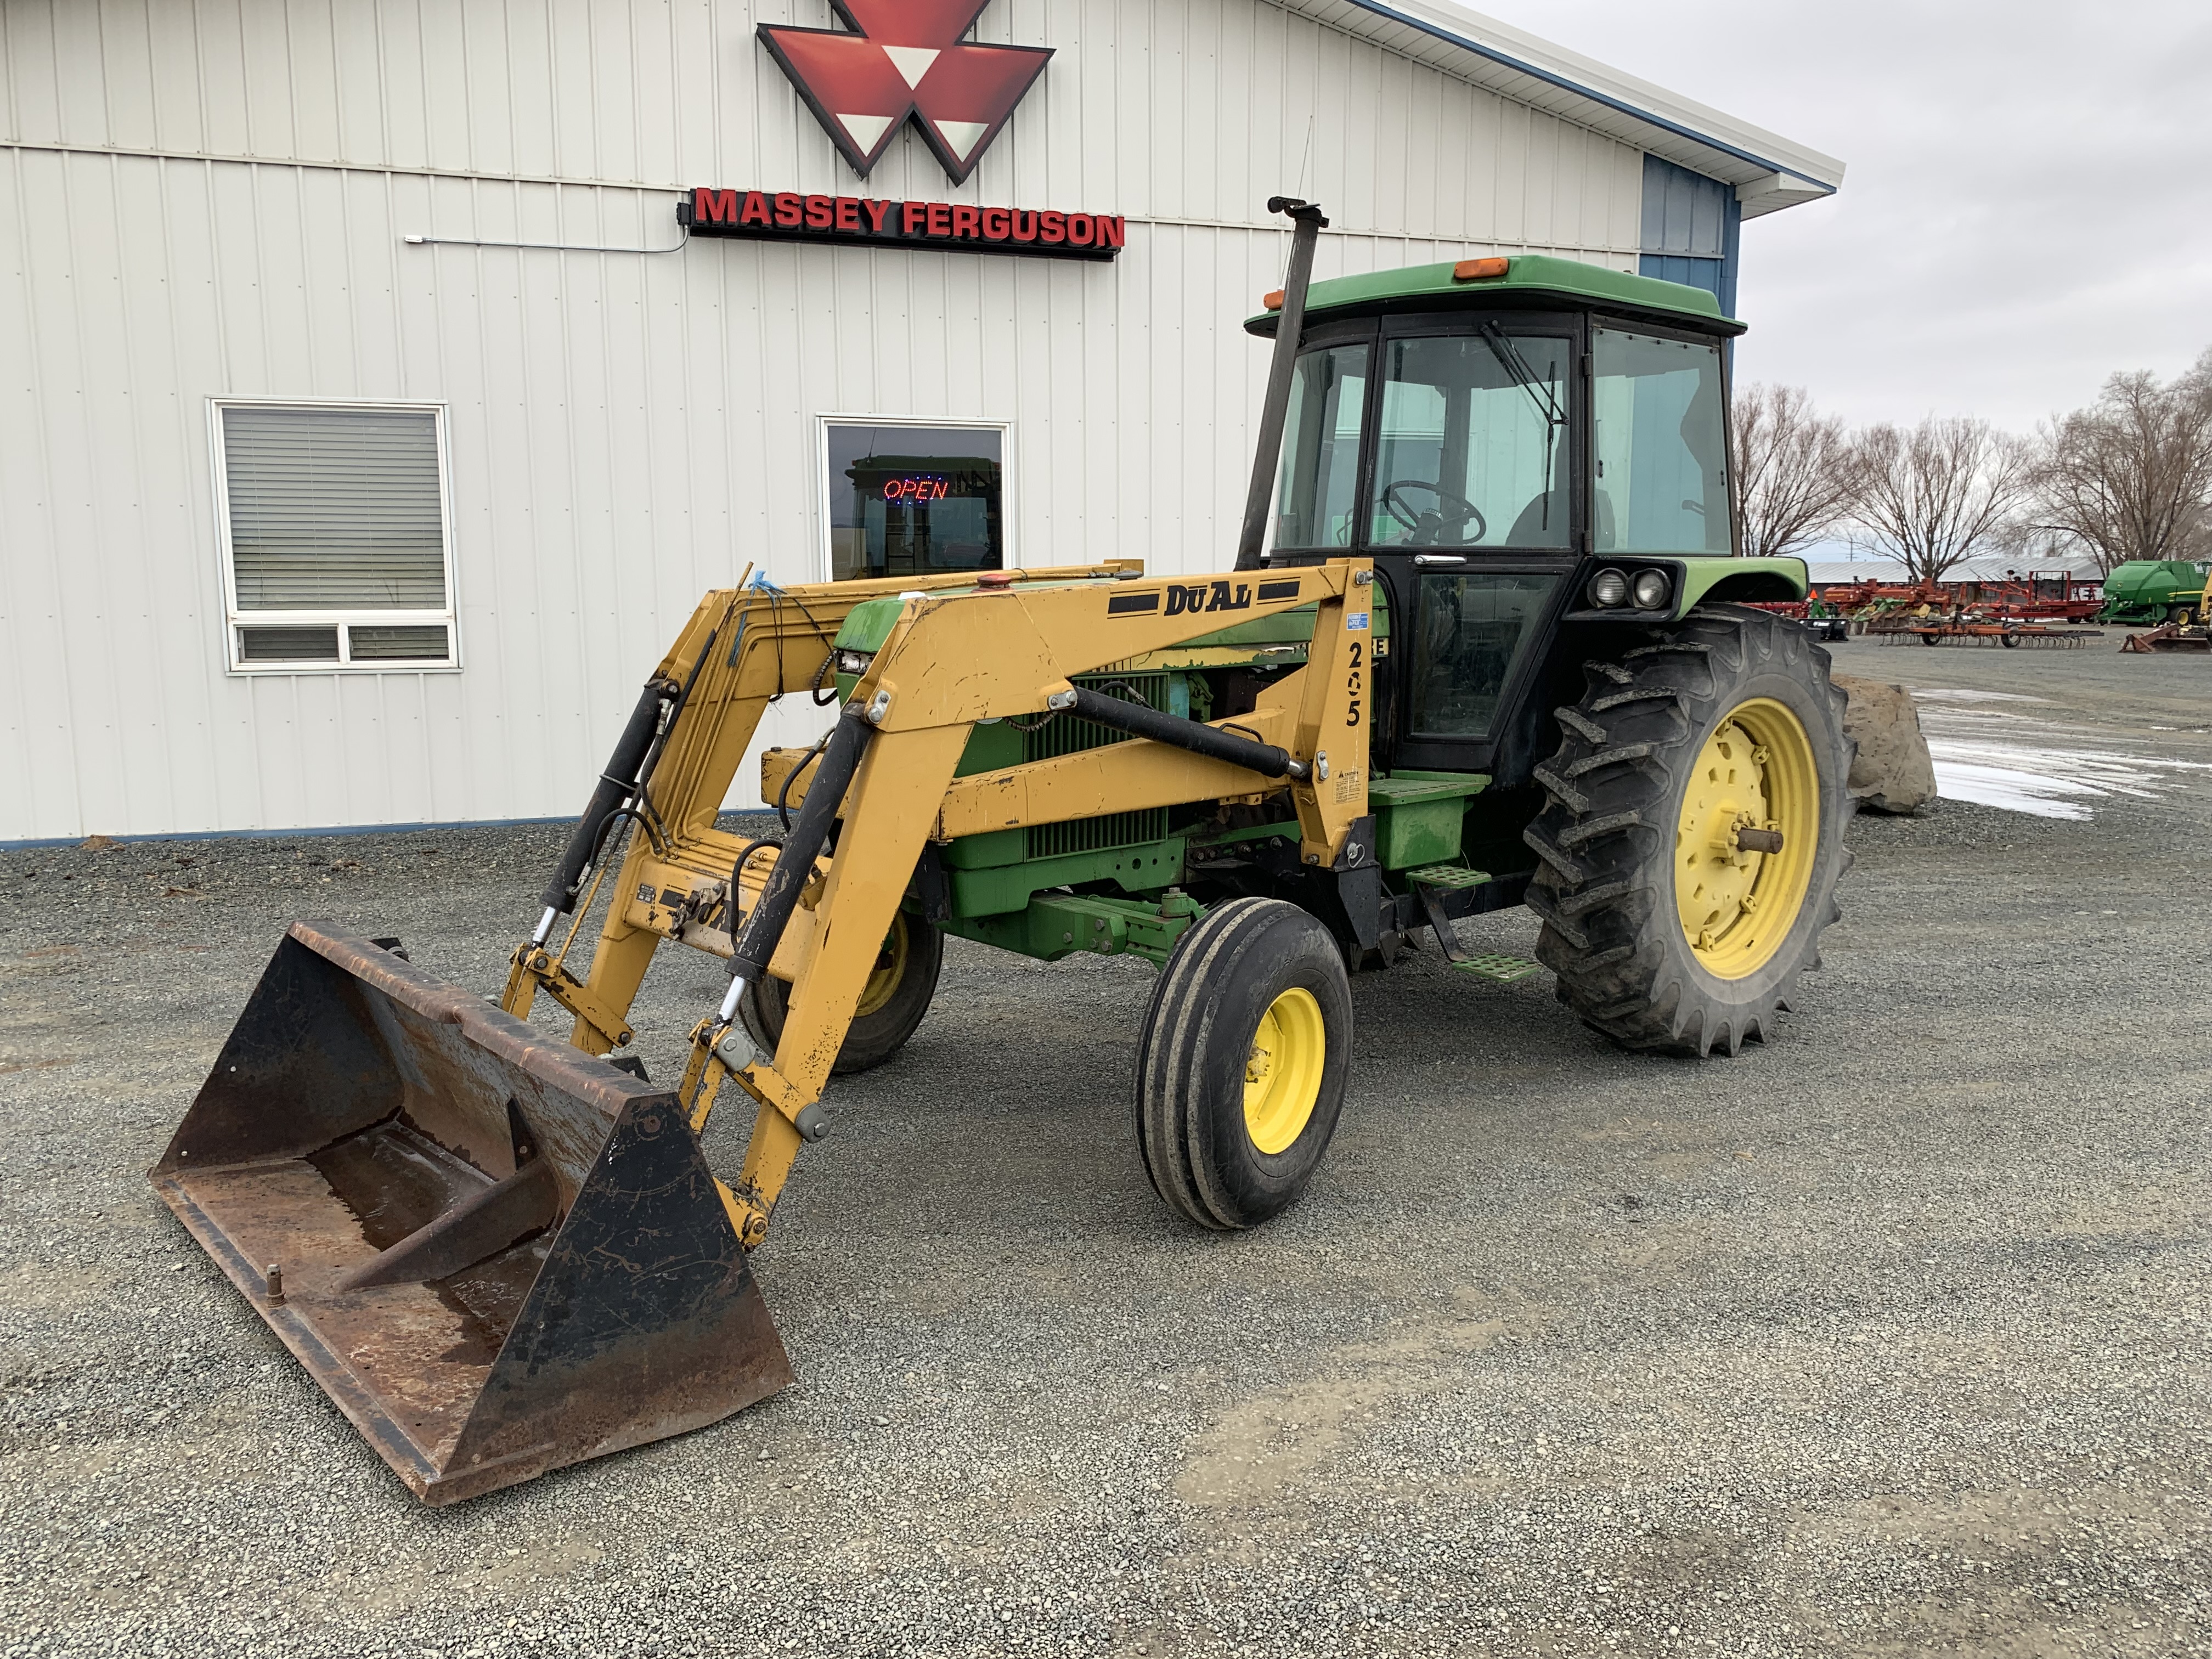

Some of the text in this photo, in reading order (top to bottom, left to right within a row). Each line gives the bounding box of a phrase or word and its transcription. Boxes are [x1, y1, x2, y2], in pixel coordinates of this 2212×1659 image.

[696, 187, 1125, 247] MASSEY FERGUSON
[883, 479, 948, 500] OPEN
[1164, 580, 1251, 616] DUAL
